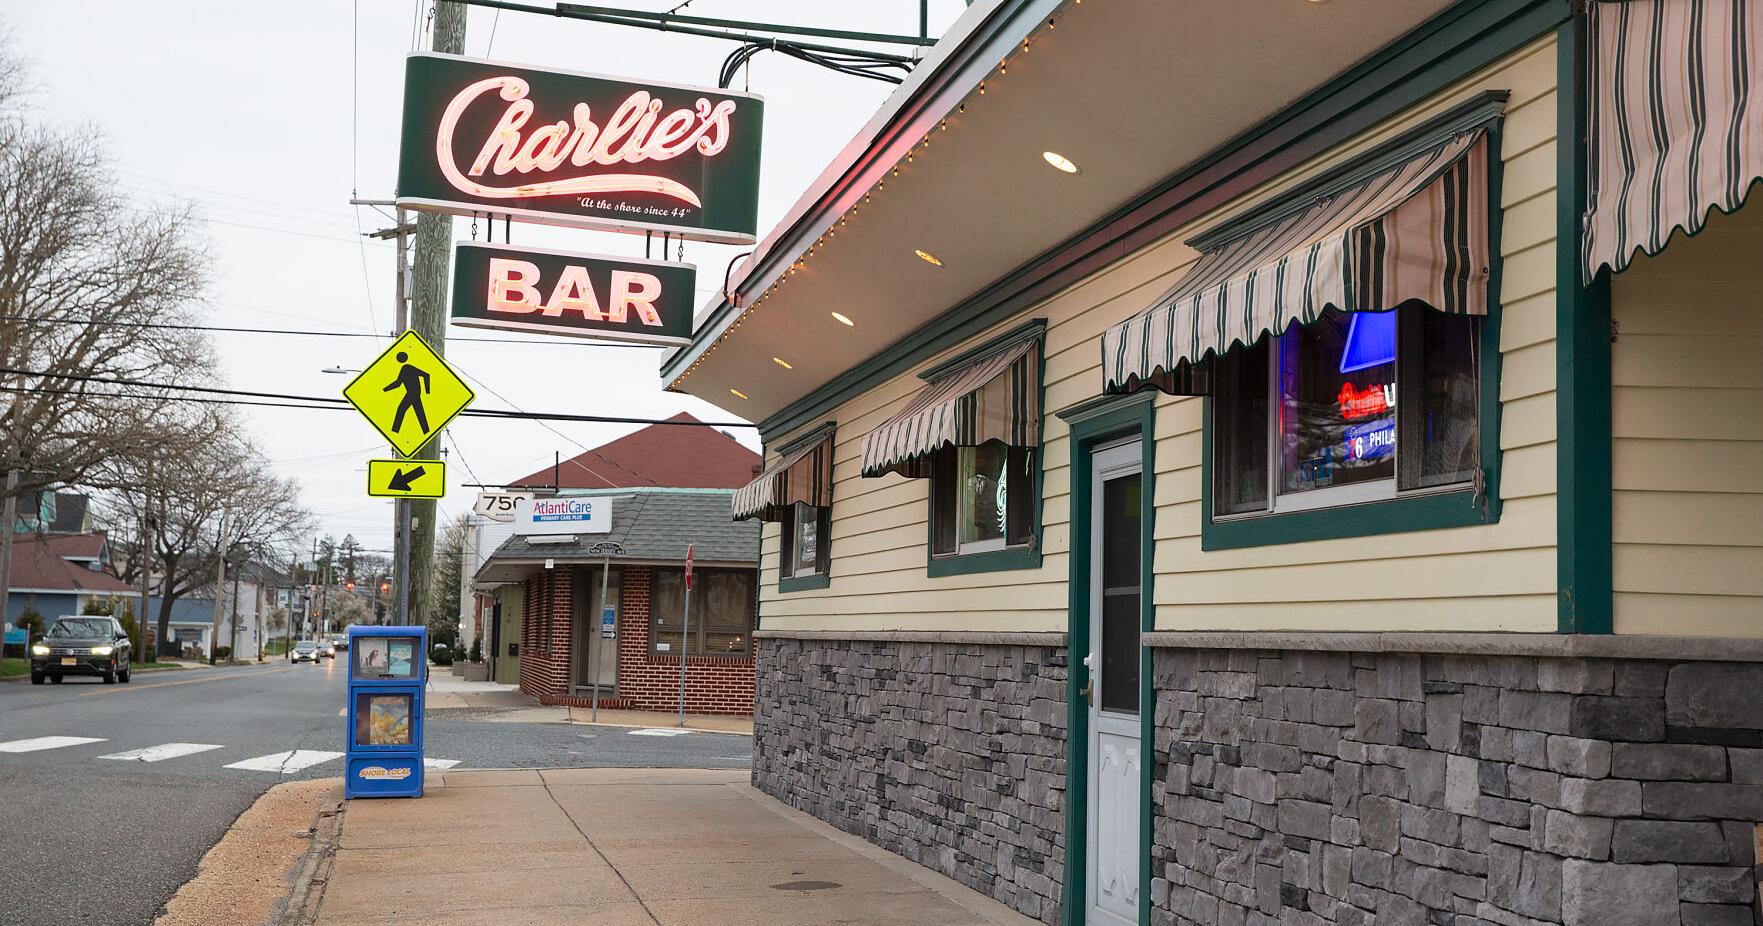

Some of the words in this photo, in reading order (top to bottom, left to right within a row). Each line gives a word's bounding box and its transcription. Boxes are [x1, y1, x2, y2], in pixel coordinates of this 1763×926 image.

[436, 76, 736, 208] Charlie's
[596, 199, 612, 210] the
[614, 201, 642, 213] shore
[643, 205, 669, 216] since
[486, 257, 664, 328] BAR
[534, 500, 592, 515] AtlantiCare
